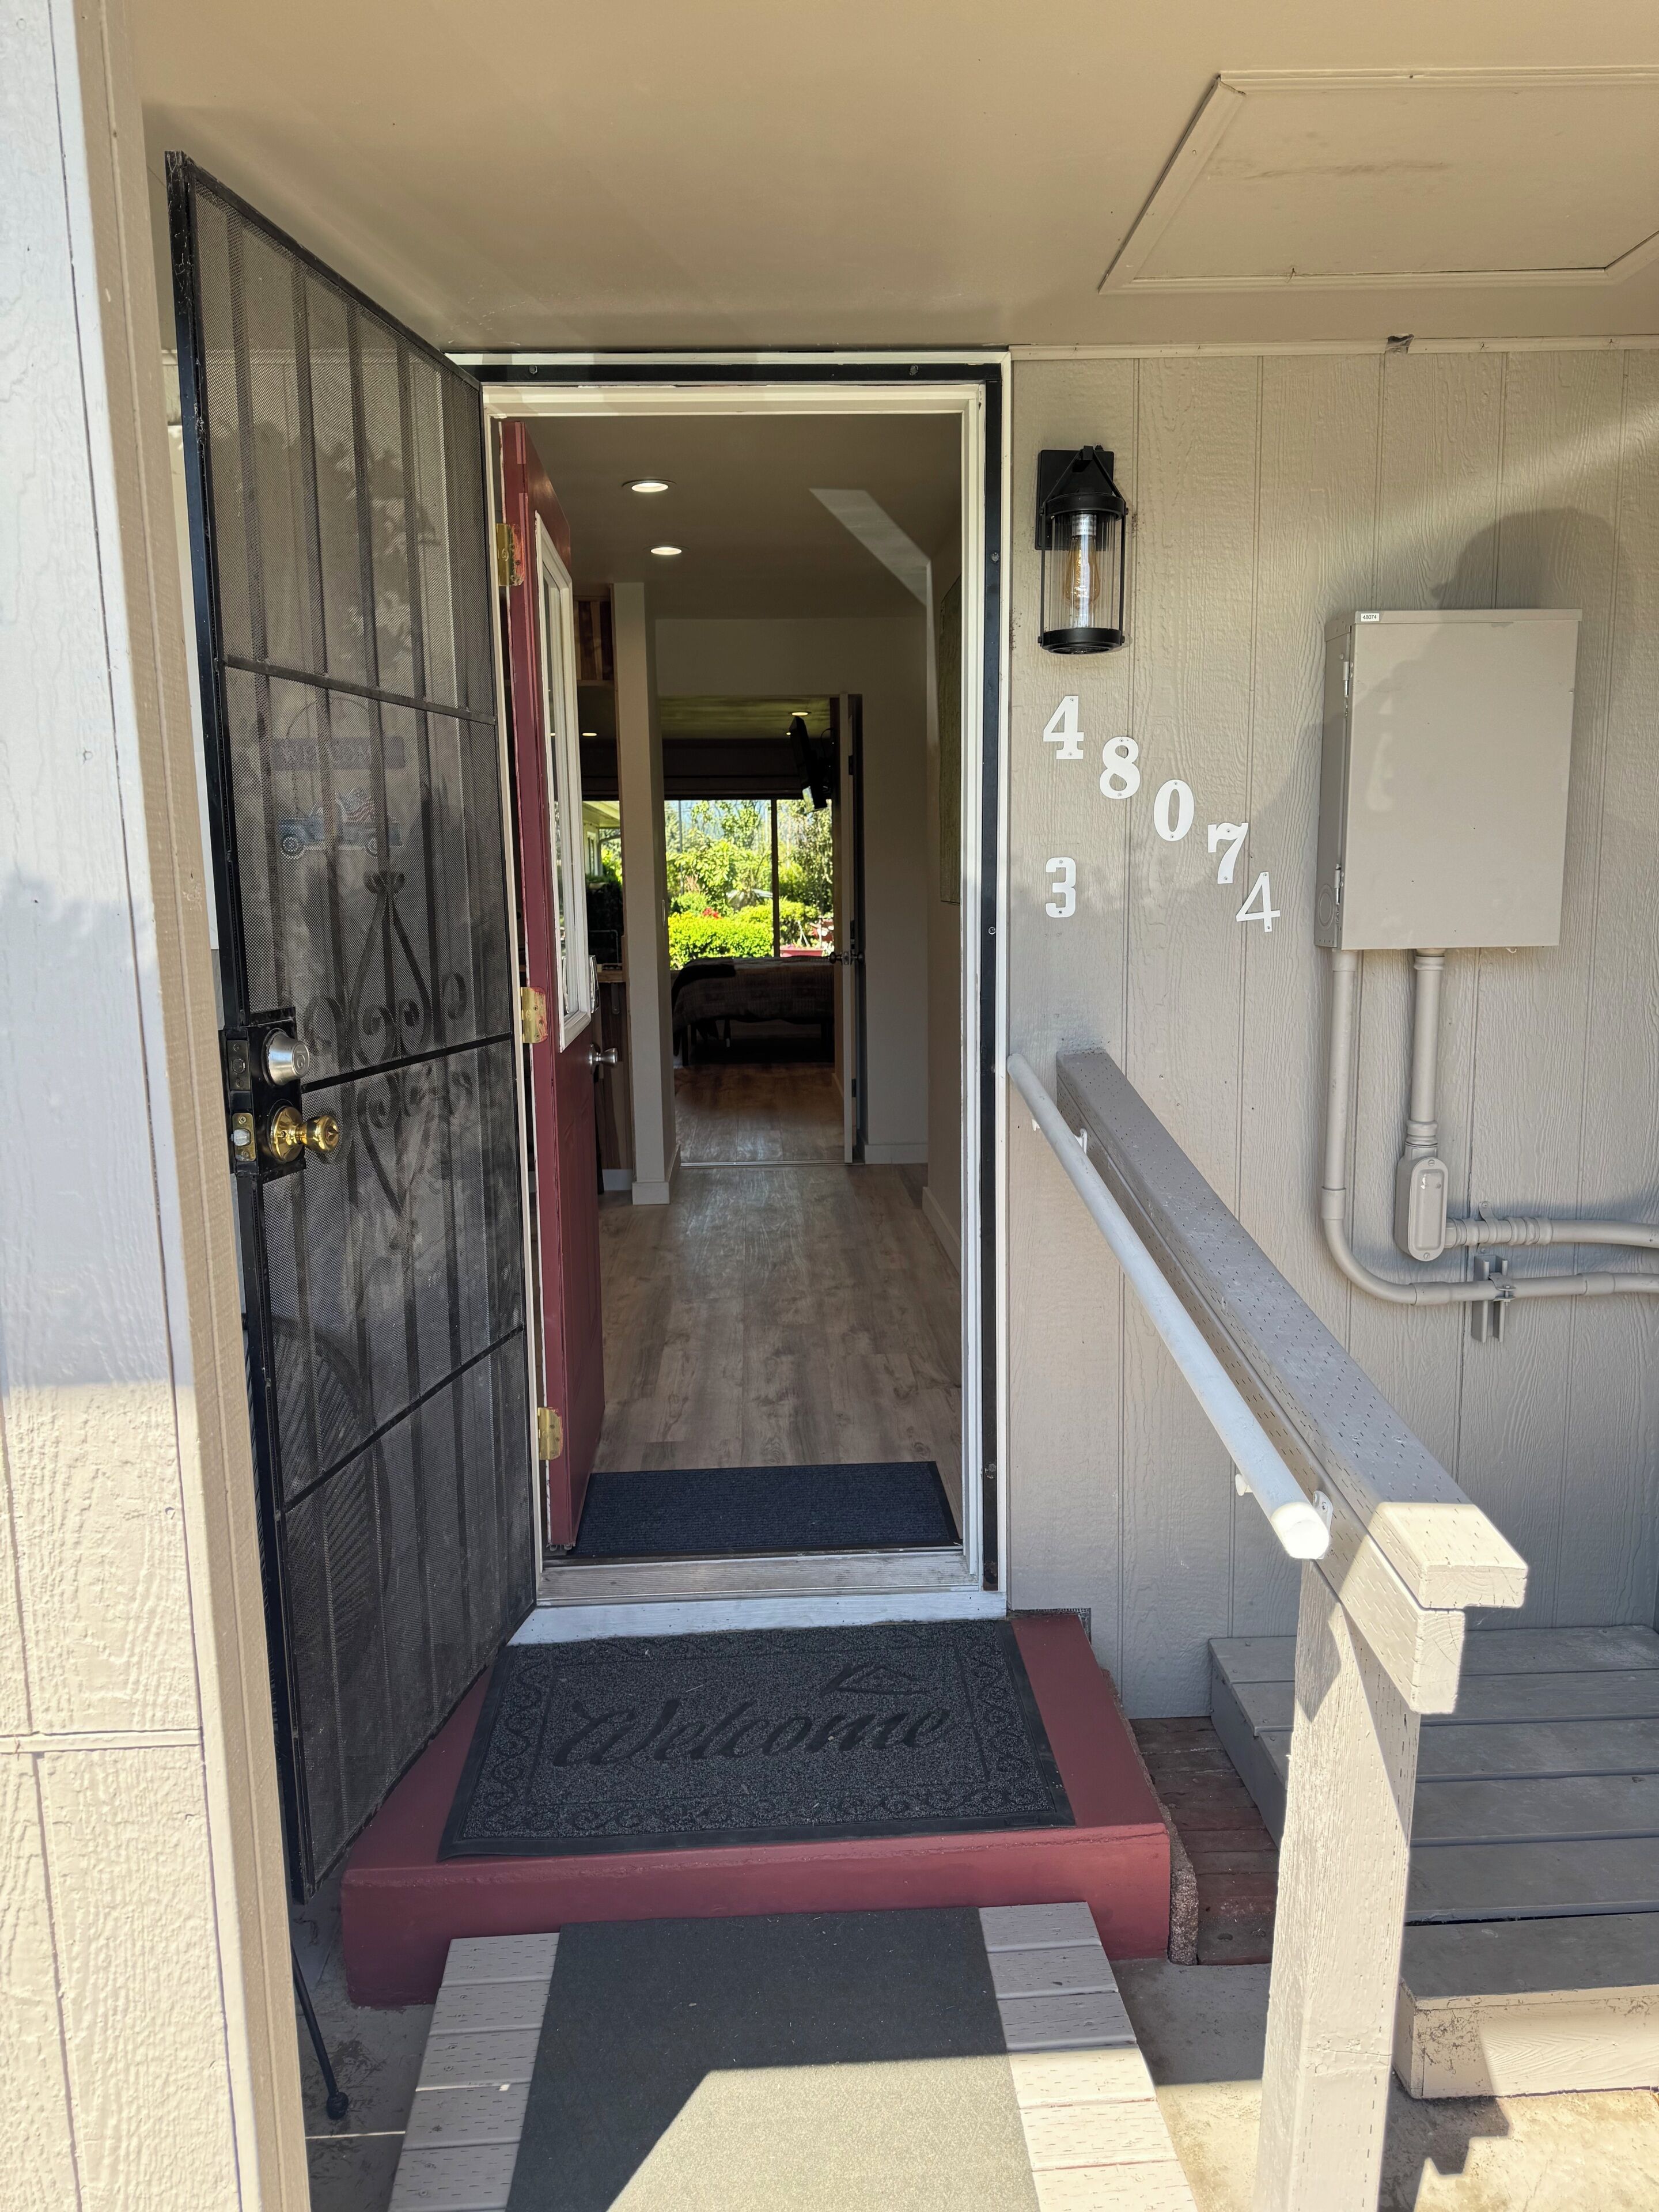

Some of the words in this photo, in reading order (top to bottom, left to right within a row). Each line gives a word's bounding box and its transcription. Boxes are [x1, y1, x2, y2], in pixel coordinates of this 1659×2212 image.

[1043, 695, 1280, 932] 48074
[1046, 857, 1076, 918] 3
[552, 1698, 952, 1767] Welcome
